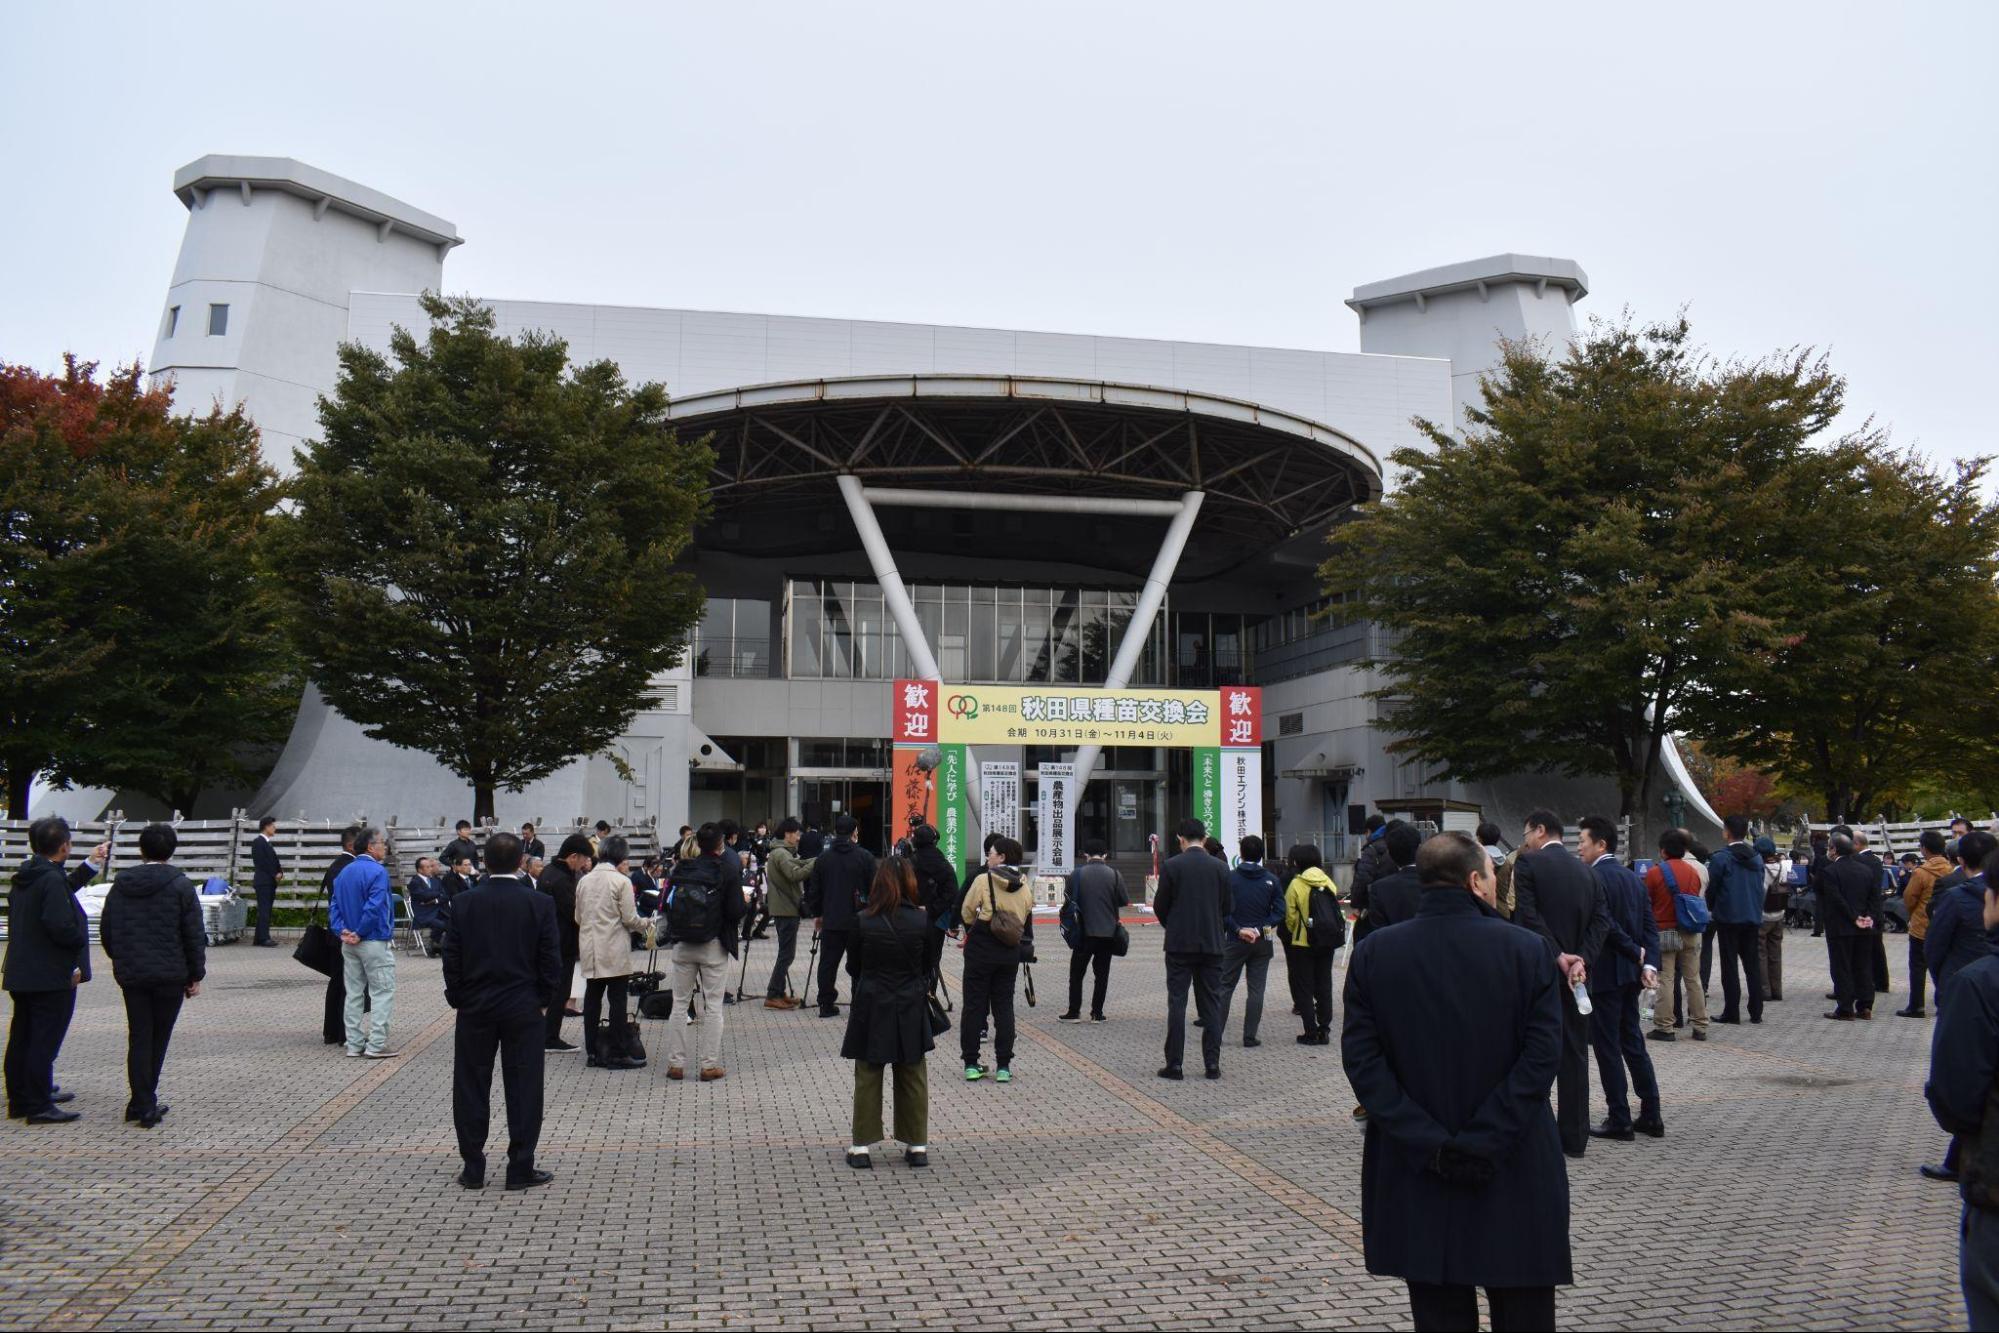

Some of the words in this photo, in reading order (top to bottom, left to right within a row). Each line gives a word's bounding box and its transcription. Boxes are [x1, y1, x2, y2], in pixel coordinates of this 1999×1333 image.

[904, 684, 929, 737] 歓迎
[982, 703, 1017, 714] 第148回
[1021, 696, 1209, 724] 秋田県種苗交換会
[1007, 727, 1027, 738] 会期
[1229, 691, 1252, 743] 歓迎
[1052, 780, 1064, 867] 農産物出品展示会場
